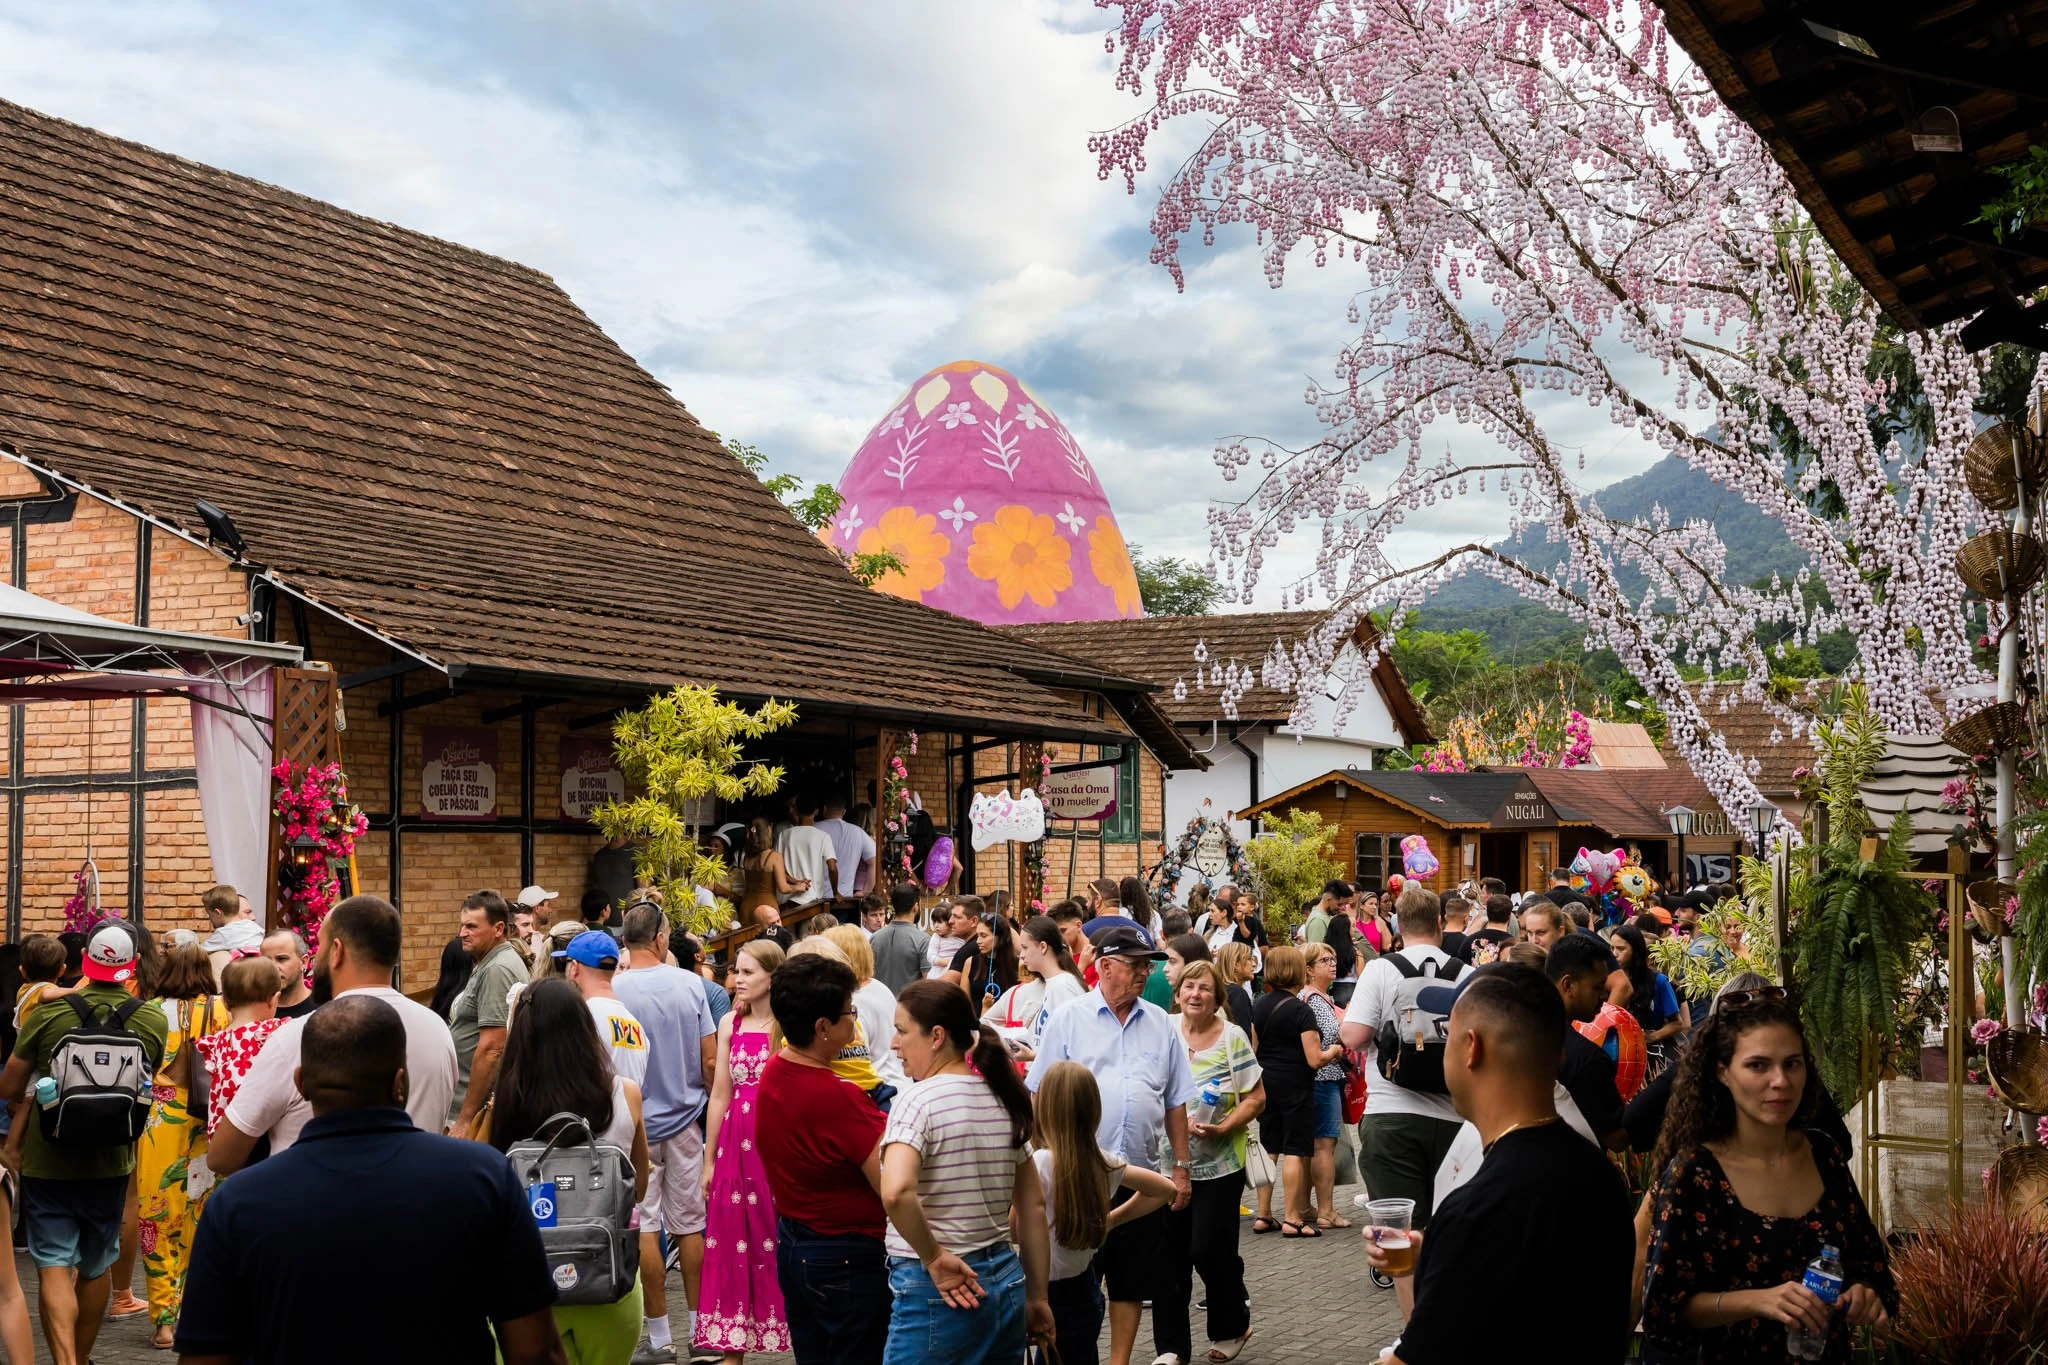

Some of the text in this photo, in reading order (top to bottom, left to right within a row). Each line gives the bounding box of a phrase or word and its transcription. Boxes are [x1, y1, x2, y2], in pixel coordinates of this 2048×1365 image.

[441, 769, 478, 783] FAÇA SEU
[579, 777, 607, 790] OFICINA
[1071, 784, 1084, 794] da
[1085, 784, 1110, 794] Oma
[429, 784, 488, 799] COELHO E CESTA
[568, 792, 576, 803] DE
[439, 796, 478, 811] DE PÁSCOA
[1067, 797, 1100, 806] mueller
[1505, 804, 1545, 820] NUGALI
[1690, 812, 1739, 836] UGAL
